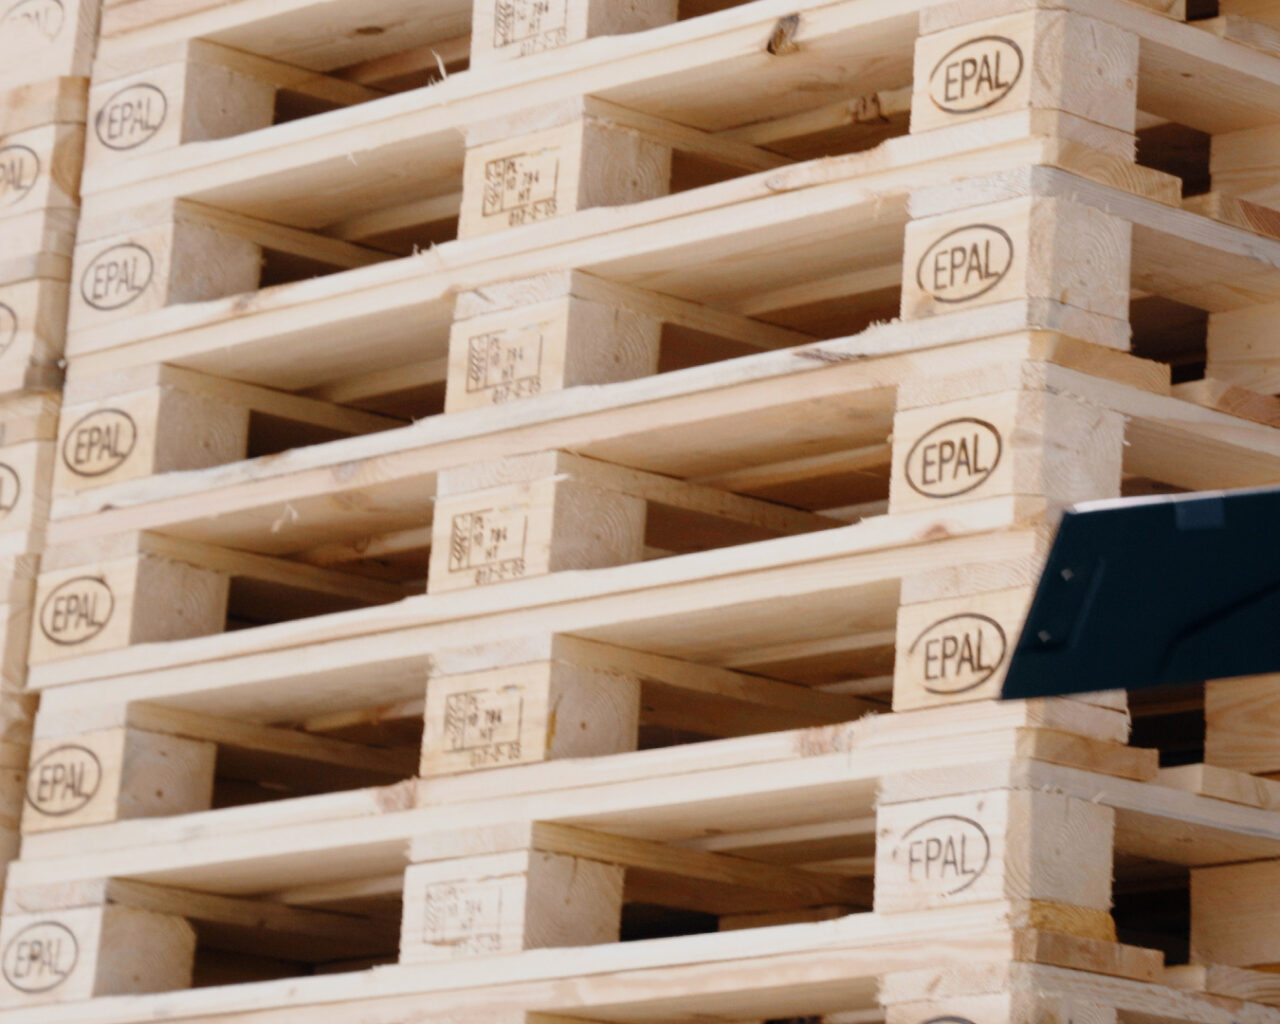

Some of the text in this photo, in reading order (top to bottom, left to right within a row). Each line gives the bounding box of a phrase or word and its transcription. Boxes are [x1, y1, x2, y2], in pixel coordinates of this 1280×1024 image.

[944, 50, 1010, 103] EPAL
[107, 97, 158, 140] EPAL
[92, 257, 144, 300] EPAL
[933, 240, 999, 291] EPAL
[74, 421, 127, 465] EPAL
[921, 433, 989, 486] EPAL
[52, 591, 105, 633] EPAL
[924, 628, 995, 681] EPAL
[37, 761, 92, 803] EPAL
[14, 938, 67, 978] EPAL
